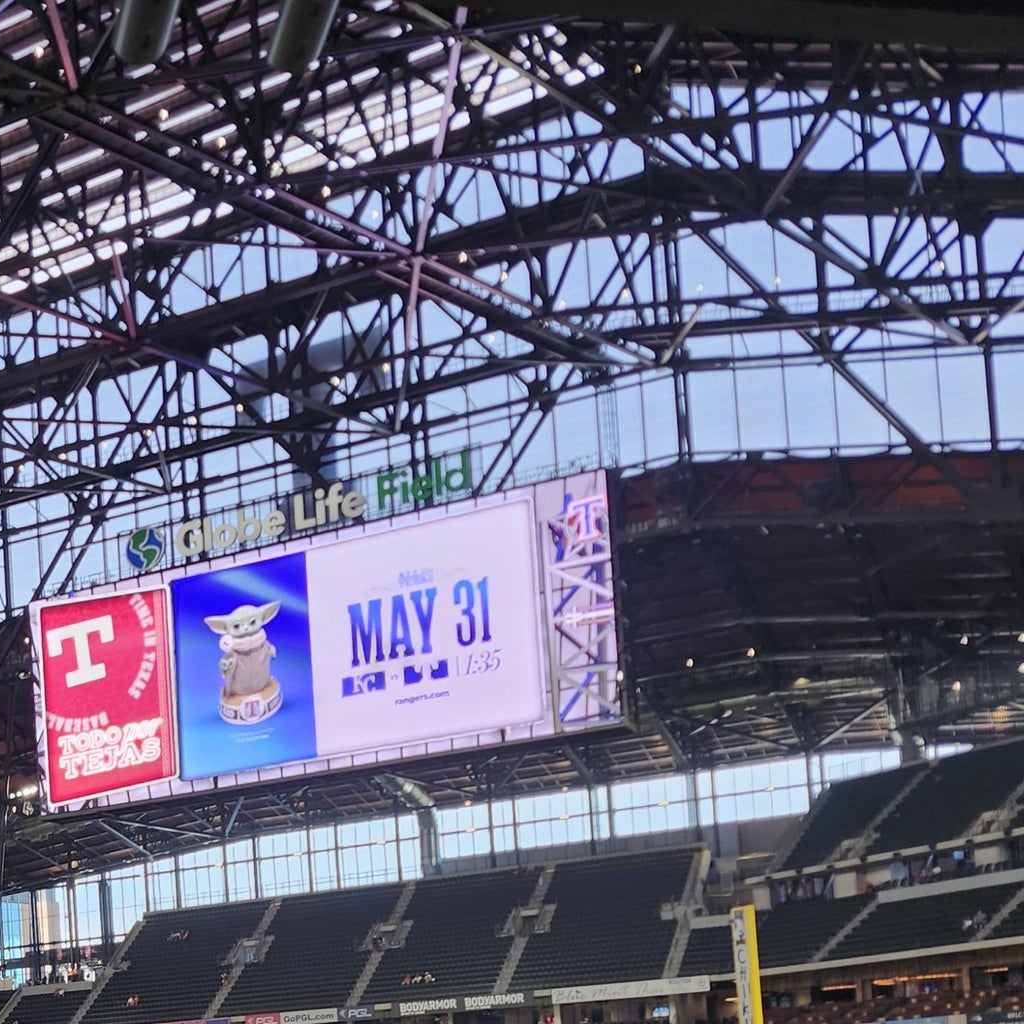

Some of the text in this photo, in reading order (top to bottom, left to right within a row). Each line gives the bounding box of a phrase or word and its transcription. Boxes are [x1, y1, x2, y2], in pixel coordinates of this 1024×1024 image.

[176, 451, 471, 557] Globe Life Field
[347, 576, 492, 668] MAY 31
[46, 614, 114, 688] T
[464, 648, 503, 676] 1:35
[395, 690, 450, 706] rangers.com
[58, 725, 122, 755] TODO
[59, 737, 162, 780] TEJAS
[283, 1012, 335, 1024] GoPGL.com
[348, 1008, 373, 1018] PGL
[399, 993, 525, 1013] BODYARMOR BODYARMOR
